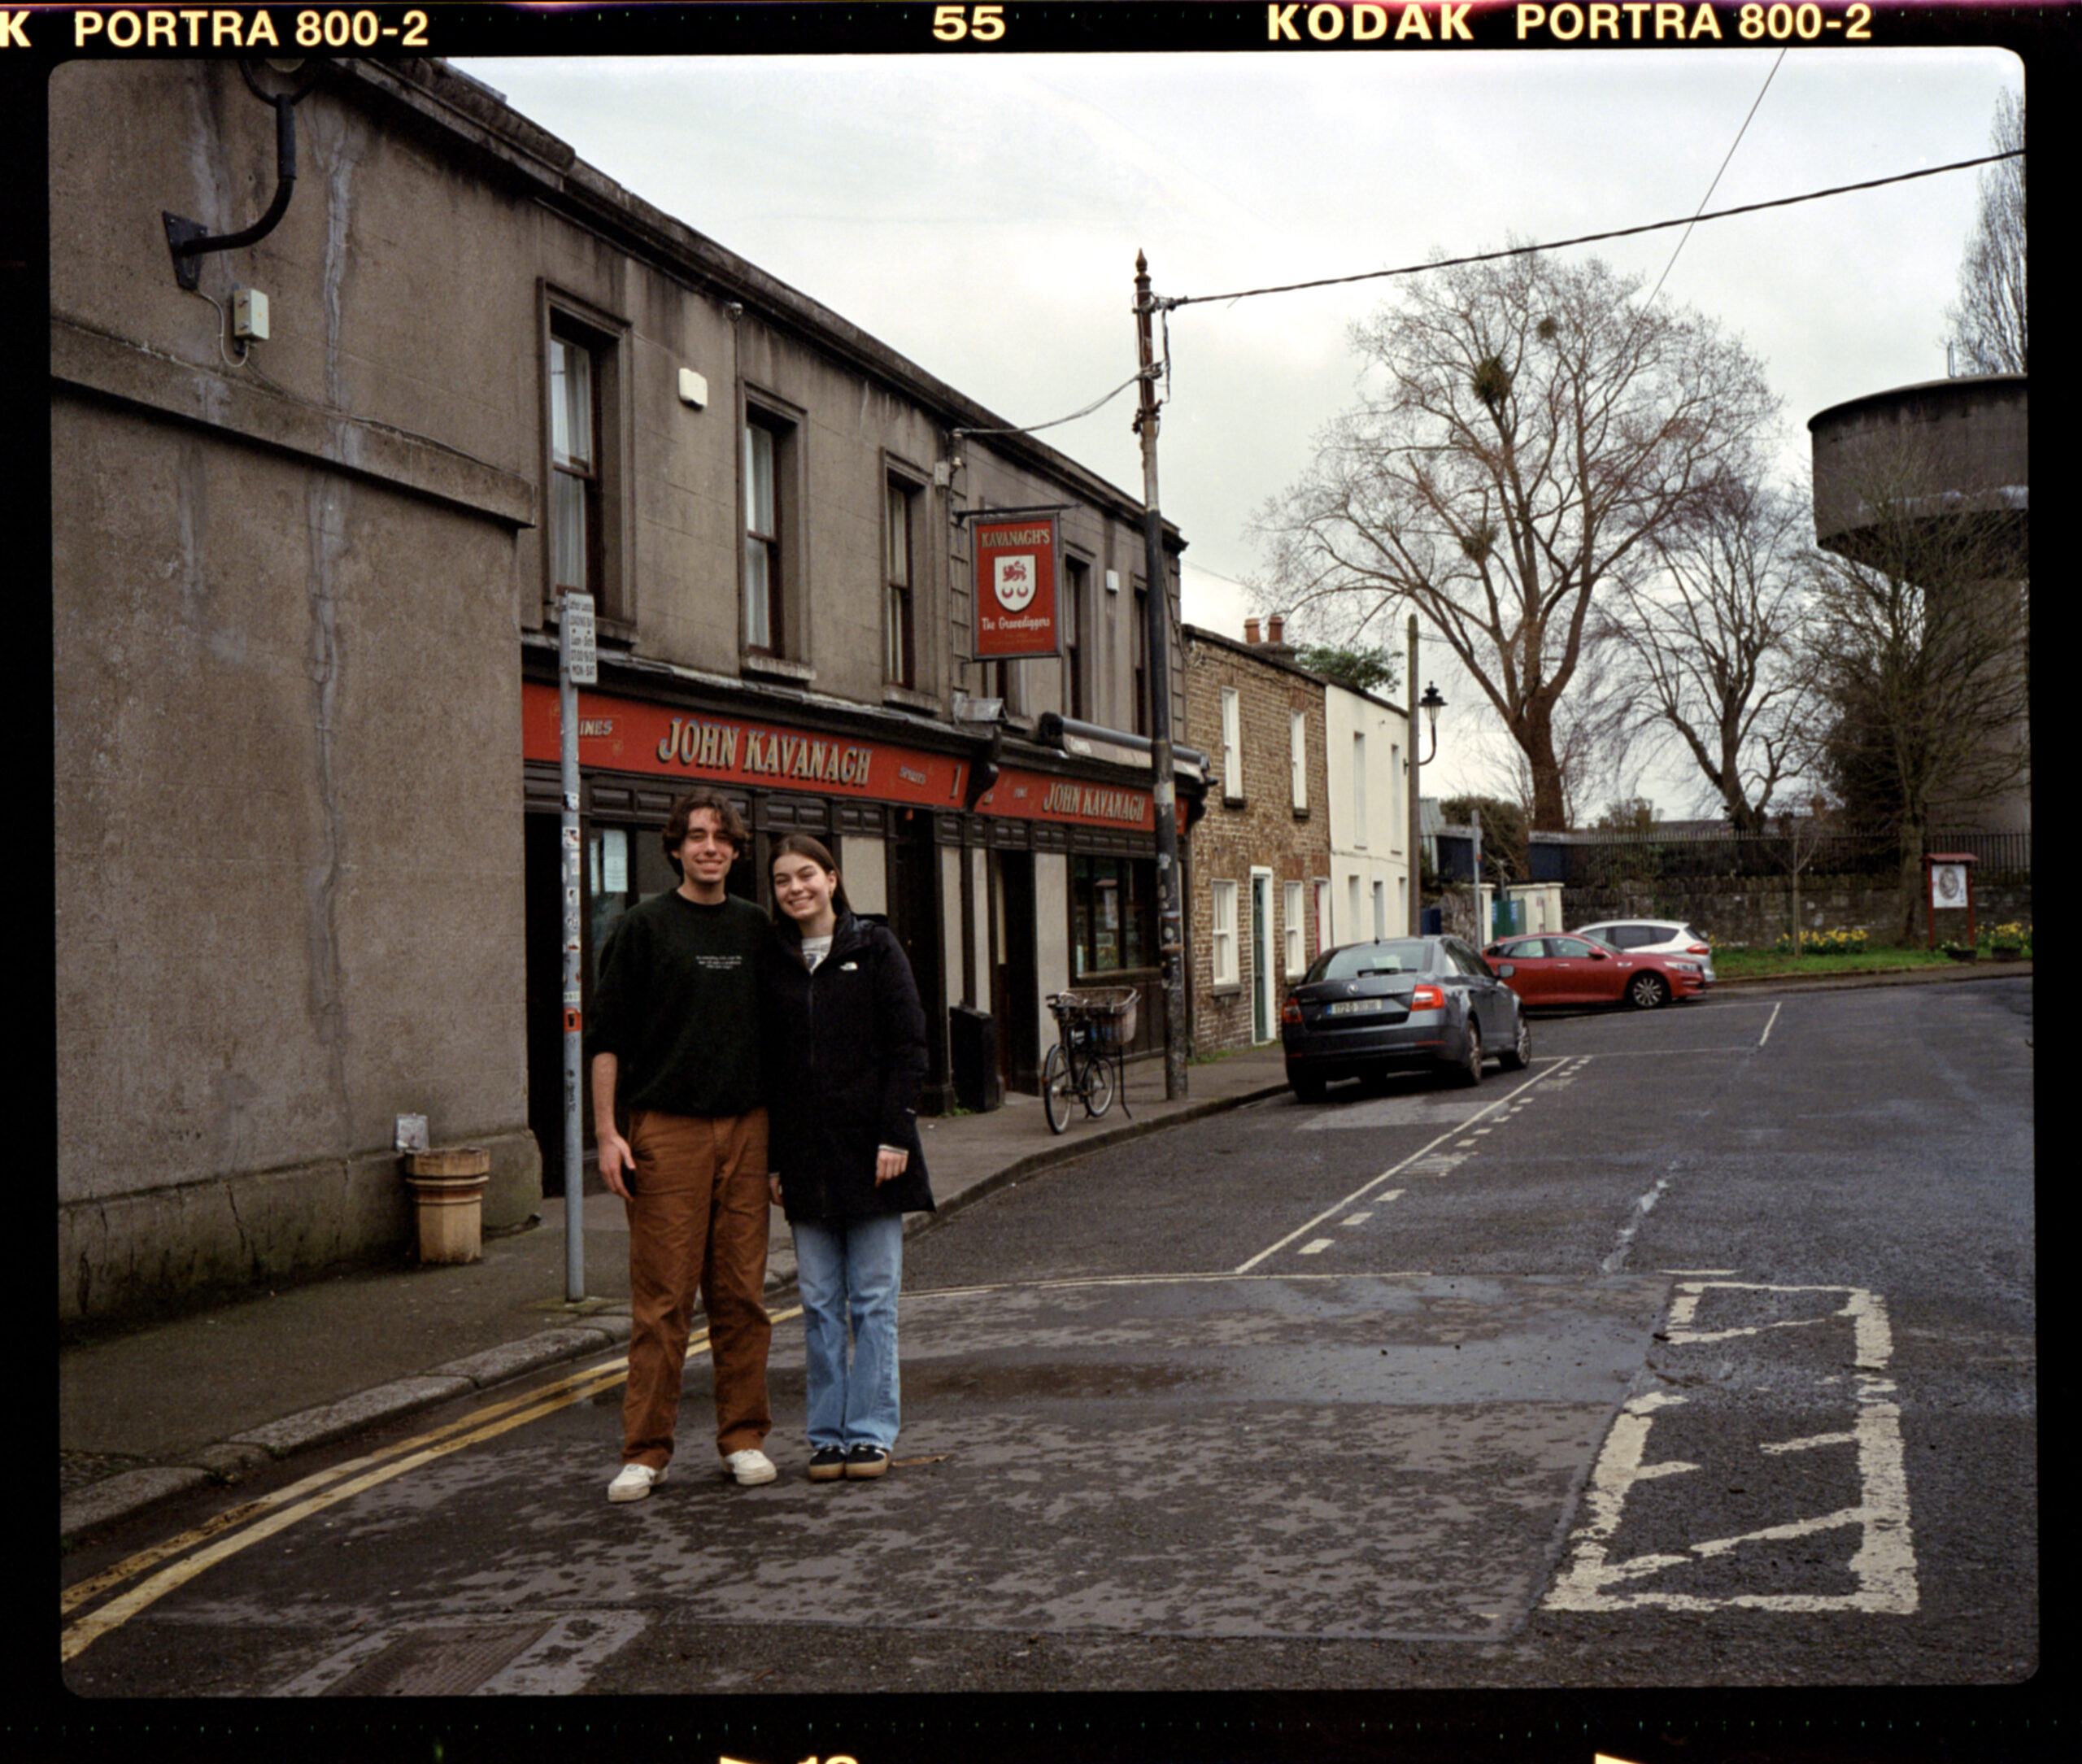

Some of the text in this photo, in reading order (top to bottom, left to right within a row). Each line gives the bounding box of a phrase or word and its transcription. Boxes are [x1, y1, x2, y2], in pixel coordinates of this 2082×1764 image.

[981, 528, 1051, 548] KAVANAGH'S
[981, 616, 995, 631] The
[657, 717, 873, 786] JOHN KAVANAGH
[1043, 782, 1082, 814] JOHN
[1082, 786, 1145, 822] KAVANAGH
